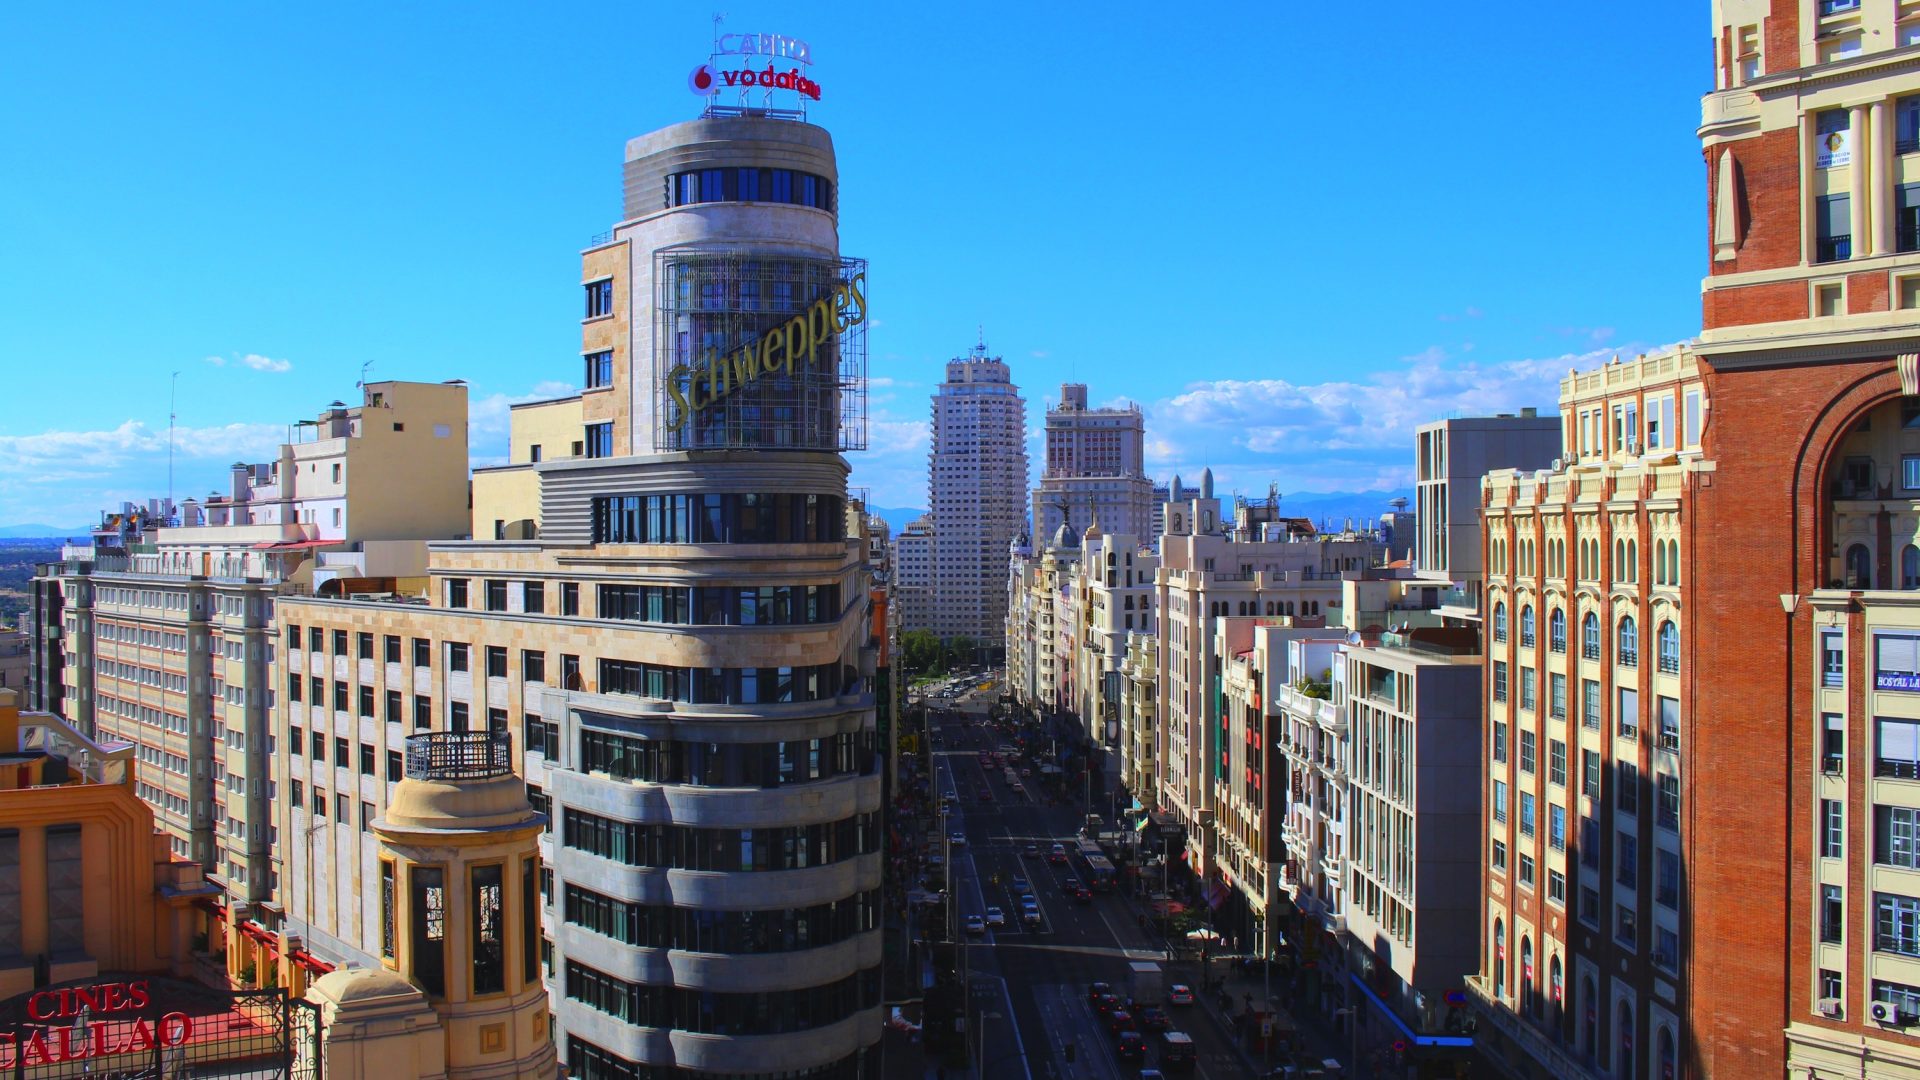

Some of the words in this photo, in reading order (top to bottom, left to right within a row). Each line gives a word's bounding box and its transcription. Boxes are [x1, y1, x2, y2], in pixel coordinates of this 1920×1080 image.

[719, 32, 814, 66] CAPITOL
[722, 64, 821, 102] vodafone
[666, 272, 867, 433] Schweppes
[1878, 676, 1908, 688] HOSTAL
[27, 979, 150, 1021] CINES
